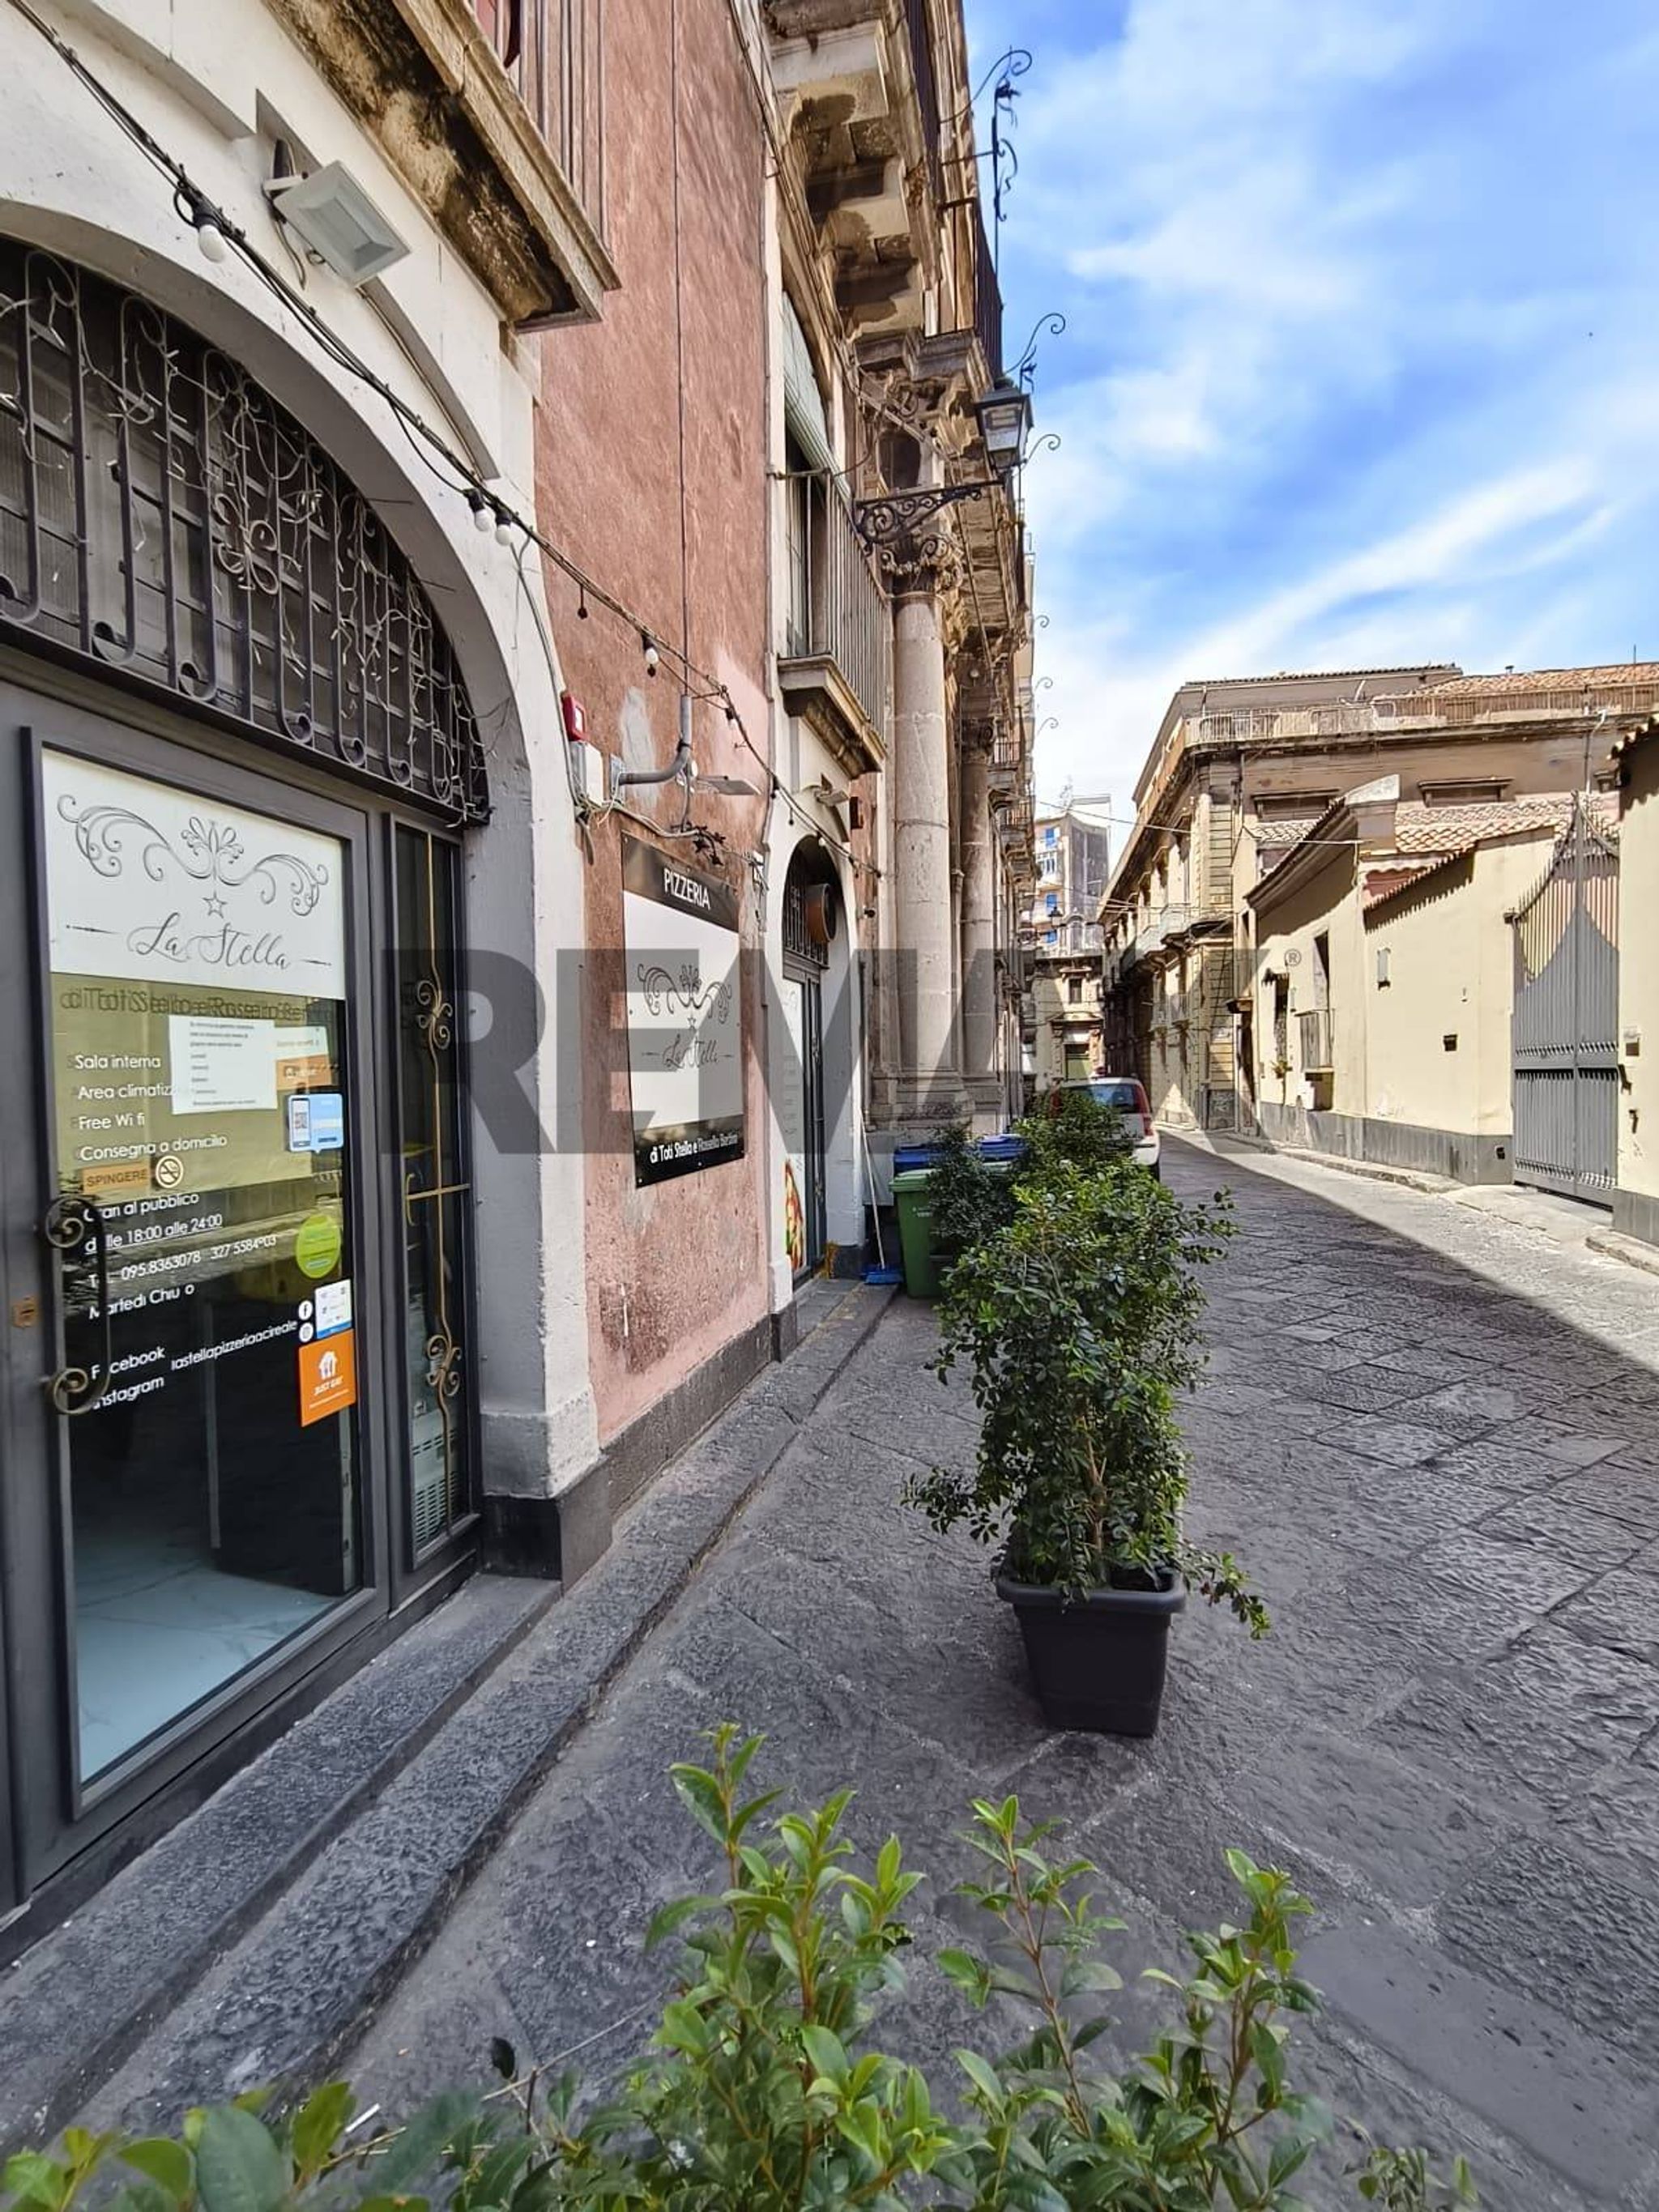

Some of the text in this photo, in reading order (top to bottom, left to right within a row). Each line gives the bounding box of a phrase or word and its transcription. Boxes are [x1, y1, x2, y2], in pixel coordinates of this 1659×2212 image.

[664, 867, 710, 910] PIZZERIA
[127, 912, 290, 970] La Stella
[75, 1055, 108, 1070] Sala
[78, 1085, 114, 1100] Area
[79, 1116, 111, 1130] Free
[81, 1135, 228, 1161] Consegna a domicilio
[87, 1168, 149, 1187] SPINGERE
[124, 1202, 137, 1216] al
[140, 1193, 199, 1216] pubblico
[85, 1213, 223, 1252] dlle 18:00 alle 24:00
[149, 1284, 194, 1305] Chiuo
[91, 1346, 166, 1380] Fcebook
[92, 1376, 165, 1409] nstagram
